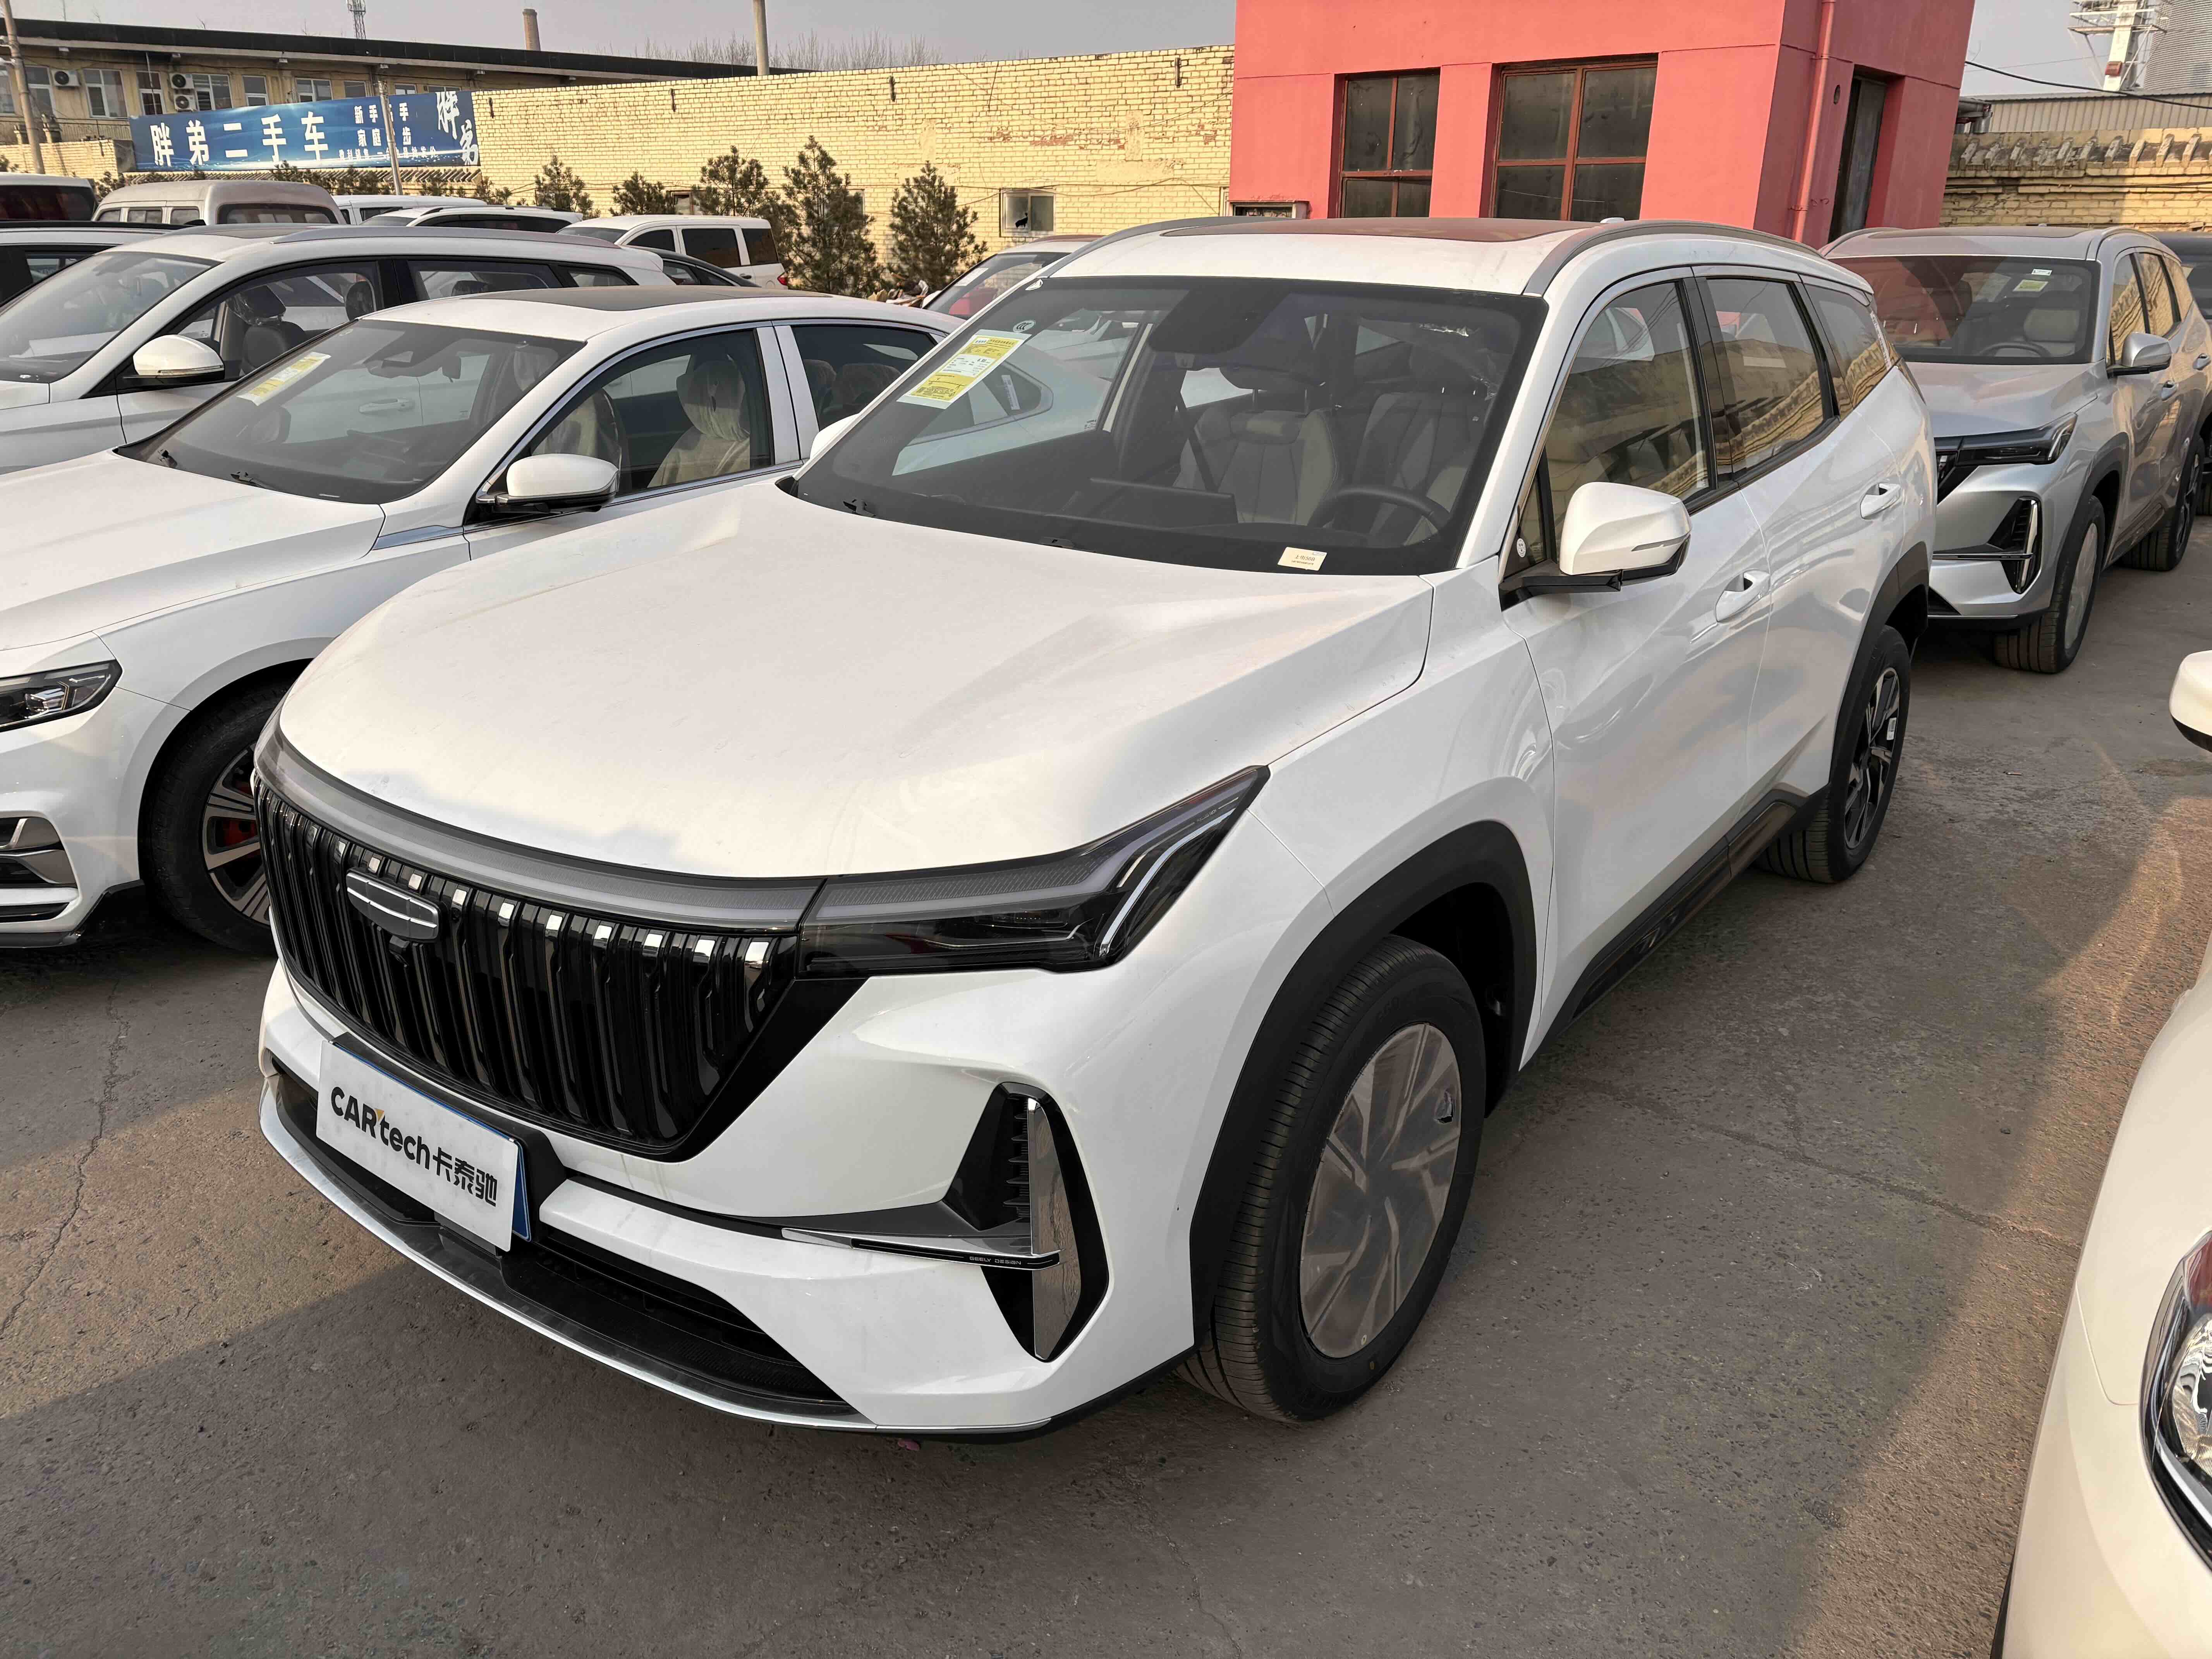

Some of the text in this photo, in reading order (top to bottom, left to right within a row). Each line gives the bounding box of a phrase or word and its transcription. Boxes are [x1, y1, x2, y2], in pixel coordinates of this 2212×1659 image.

[149, 112, 329, 167] 胖弟二手车
[357, 127, 411, 147] 家庭步
[331, 1086, 498, 1207] CARtech 卡泰驰
